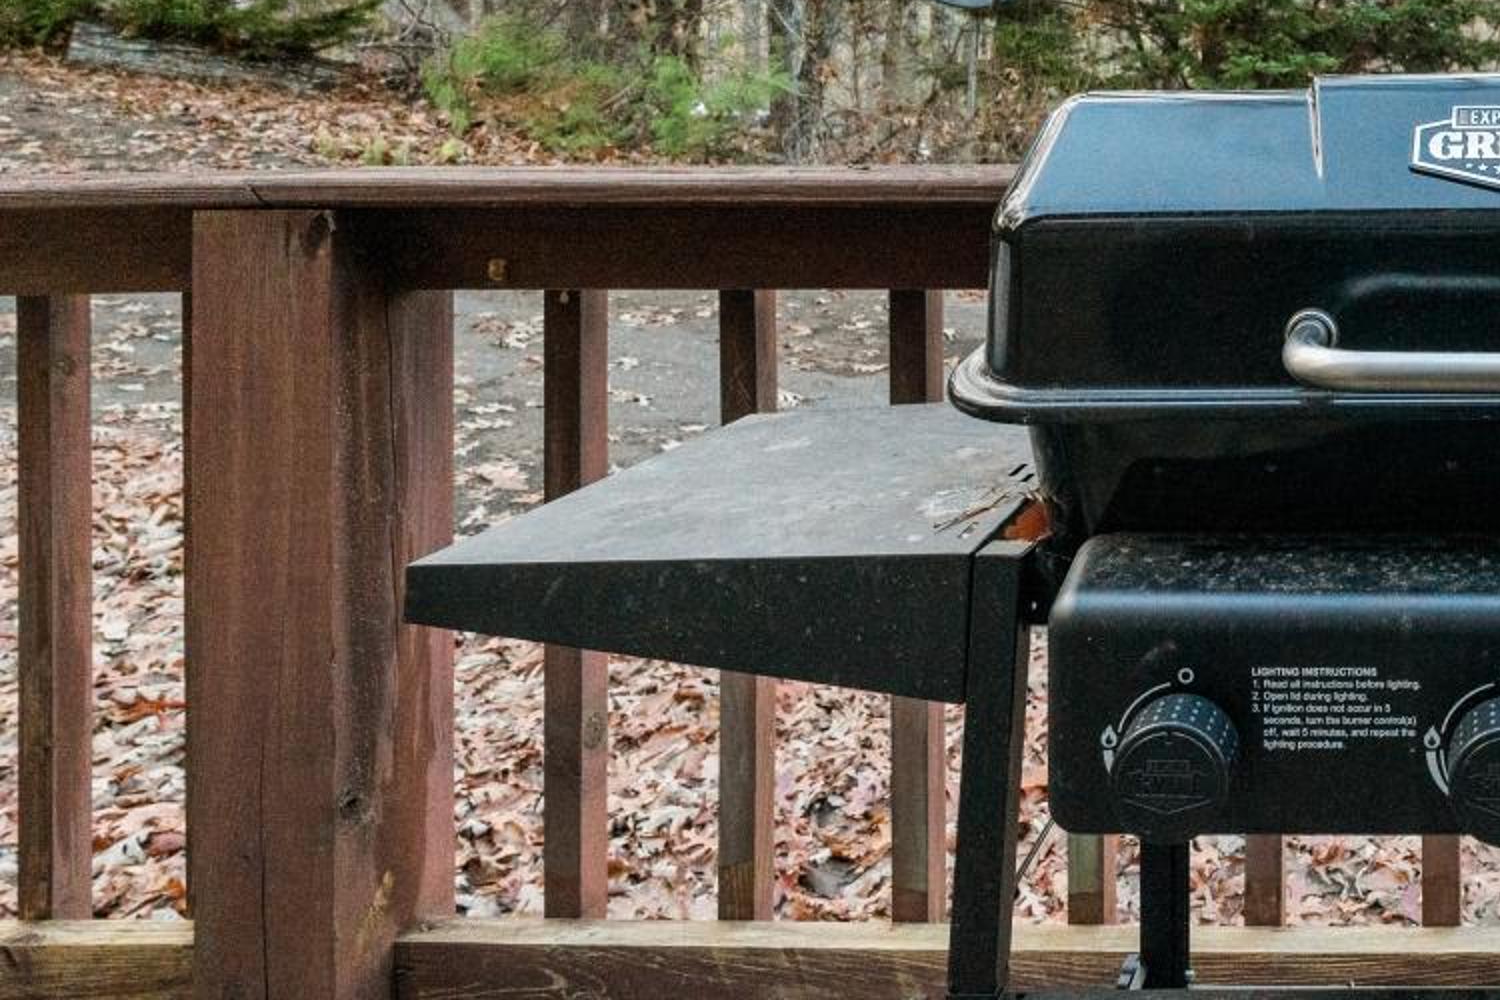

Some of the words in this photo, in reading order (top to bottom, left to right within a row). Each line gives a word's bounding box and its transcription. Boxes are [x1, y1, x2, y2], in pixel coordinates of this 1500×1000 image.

[1251, 667, 1300, 676] LIGHTING
[1302, 667, 1377, 676] INSTRUCTIONS
[1253, 679, 1260, 688] 1.
[1264, 679, 1288, 688] Read
[1290, 679, 1300, 688] all
[1302, 679, 1354, 688] instructions
[1356, 679, 1384, 688] before
[1386, 679, 1421, 690] lighting.
[1251, 692, 1260, 700] 2.
[1264, 692, 1288, 702] Open
[1290, 692, 1300, 700] lid
[1303, 692, 1332, 702] during
[1334, 692, 1368, 702] lighting.
[1251, 704, 1260, 712] 3.
[1272, 704, 1304, 714] ignition
[1306, 704, 1328, 712] does
[1330, 704, 1344, 712] not
[1374, 704, 1382, 712] in
[1306, 716, 1324, 724] turn
[1326, 716, 1340, 724] the
[1342, 716, 1371, 724] burner
[1282, 728, 1300, 736] wait
[1302, 728, 1308, 736] 5
[1310, 728, 1348, 738] minutes,
[1350, 728, 1368, 736] and
[1370, 728, 1398, 738] repeat
[1401, 728, 1416, 736] the
[1264, 740, 1296, 750] lighting
